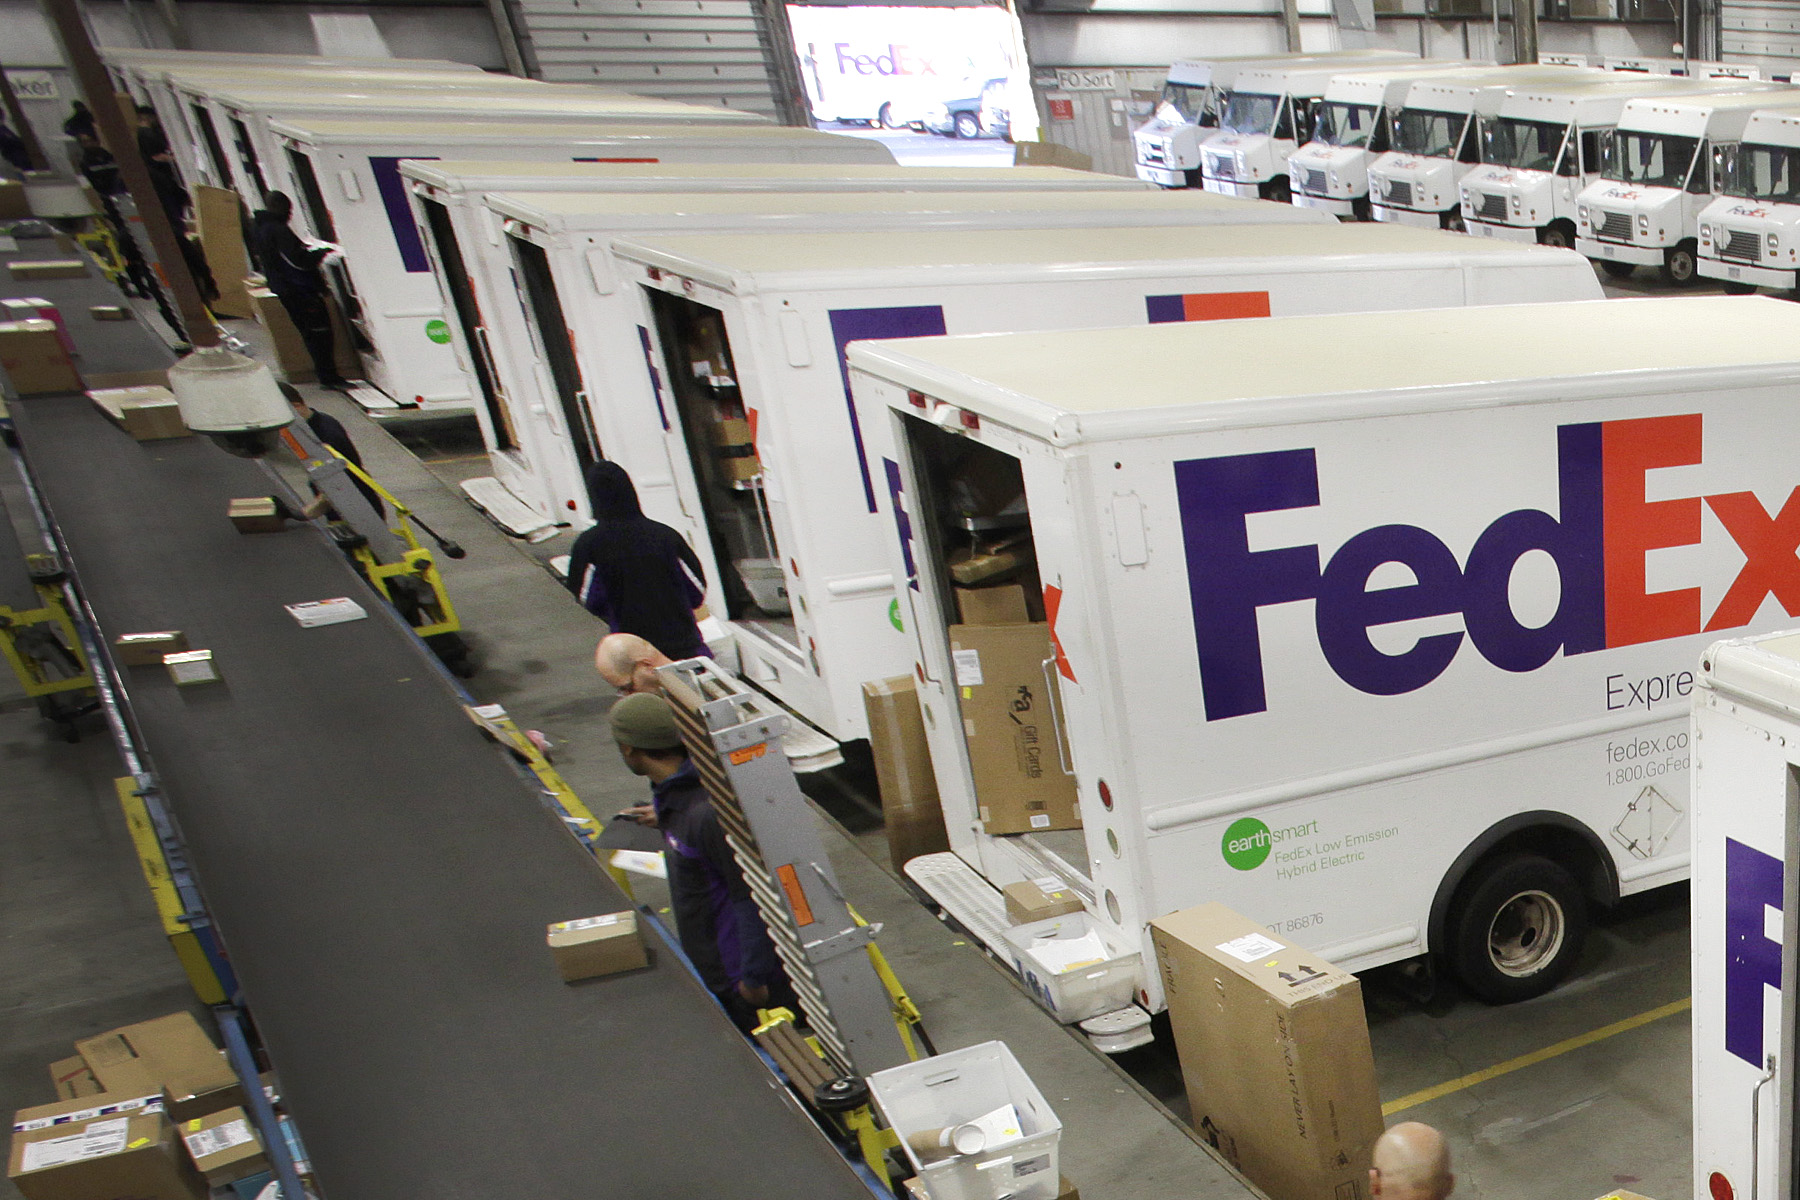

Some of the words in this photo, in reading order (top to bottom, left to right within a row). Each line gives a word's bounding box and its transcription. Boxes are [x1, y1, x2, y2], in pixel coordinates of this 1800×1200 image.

[835, 42, 937, 76] FedEx
[1060, 71, 1081, 88] FO
[1084, 69, 1112, 88] Sort
[1726, 204, 1771, 218] FedEx
[1606, 671, 1694, 711] Expre
[1605, 732, 1688, 764] fedex.co
[1605, 753, 1690, 786] 1.800.GoFed
[1274, 846, 1312, 864] FedEx
[1315, 839, 1342, 855] Low
[1345, 825, 1400, 847] Emission
[1276, 860, 1317, 881] Hybrid
[1321, 850, 1366, 870] Electric
[1266, 922, 1283, 935] OT
[1287, 912, 1325, 933] 86876
[1288, 986, 1312, 997] THIS
